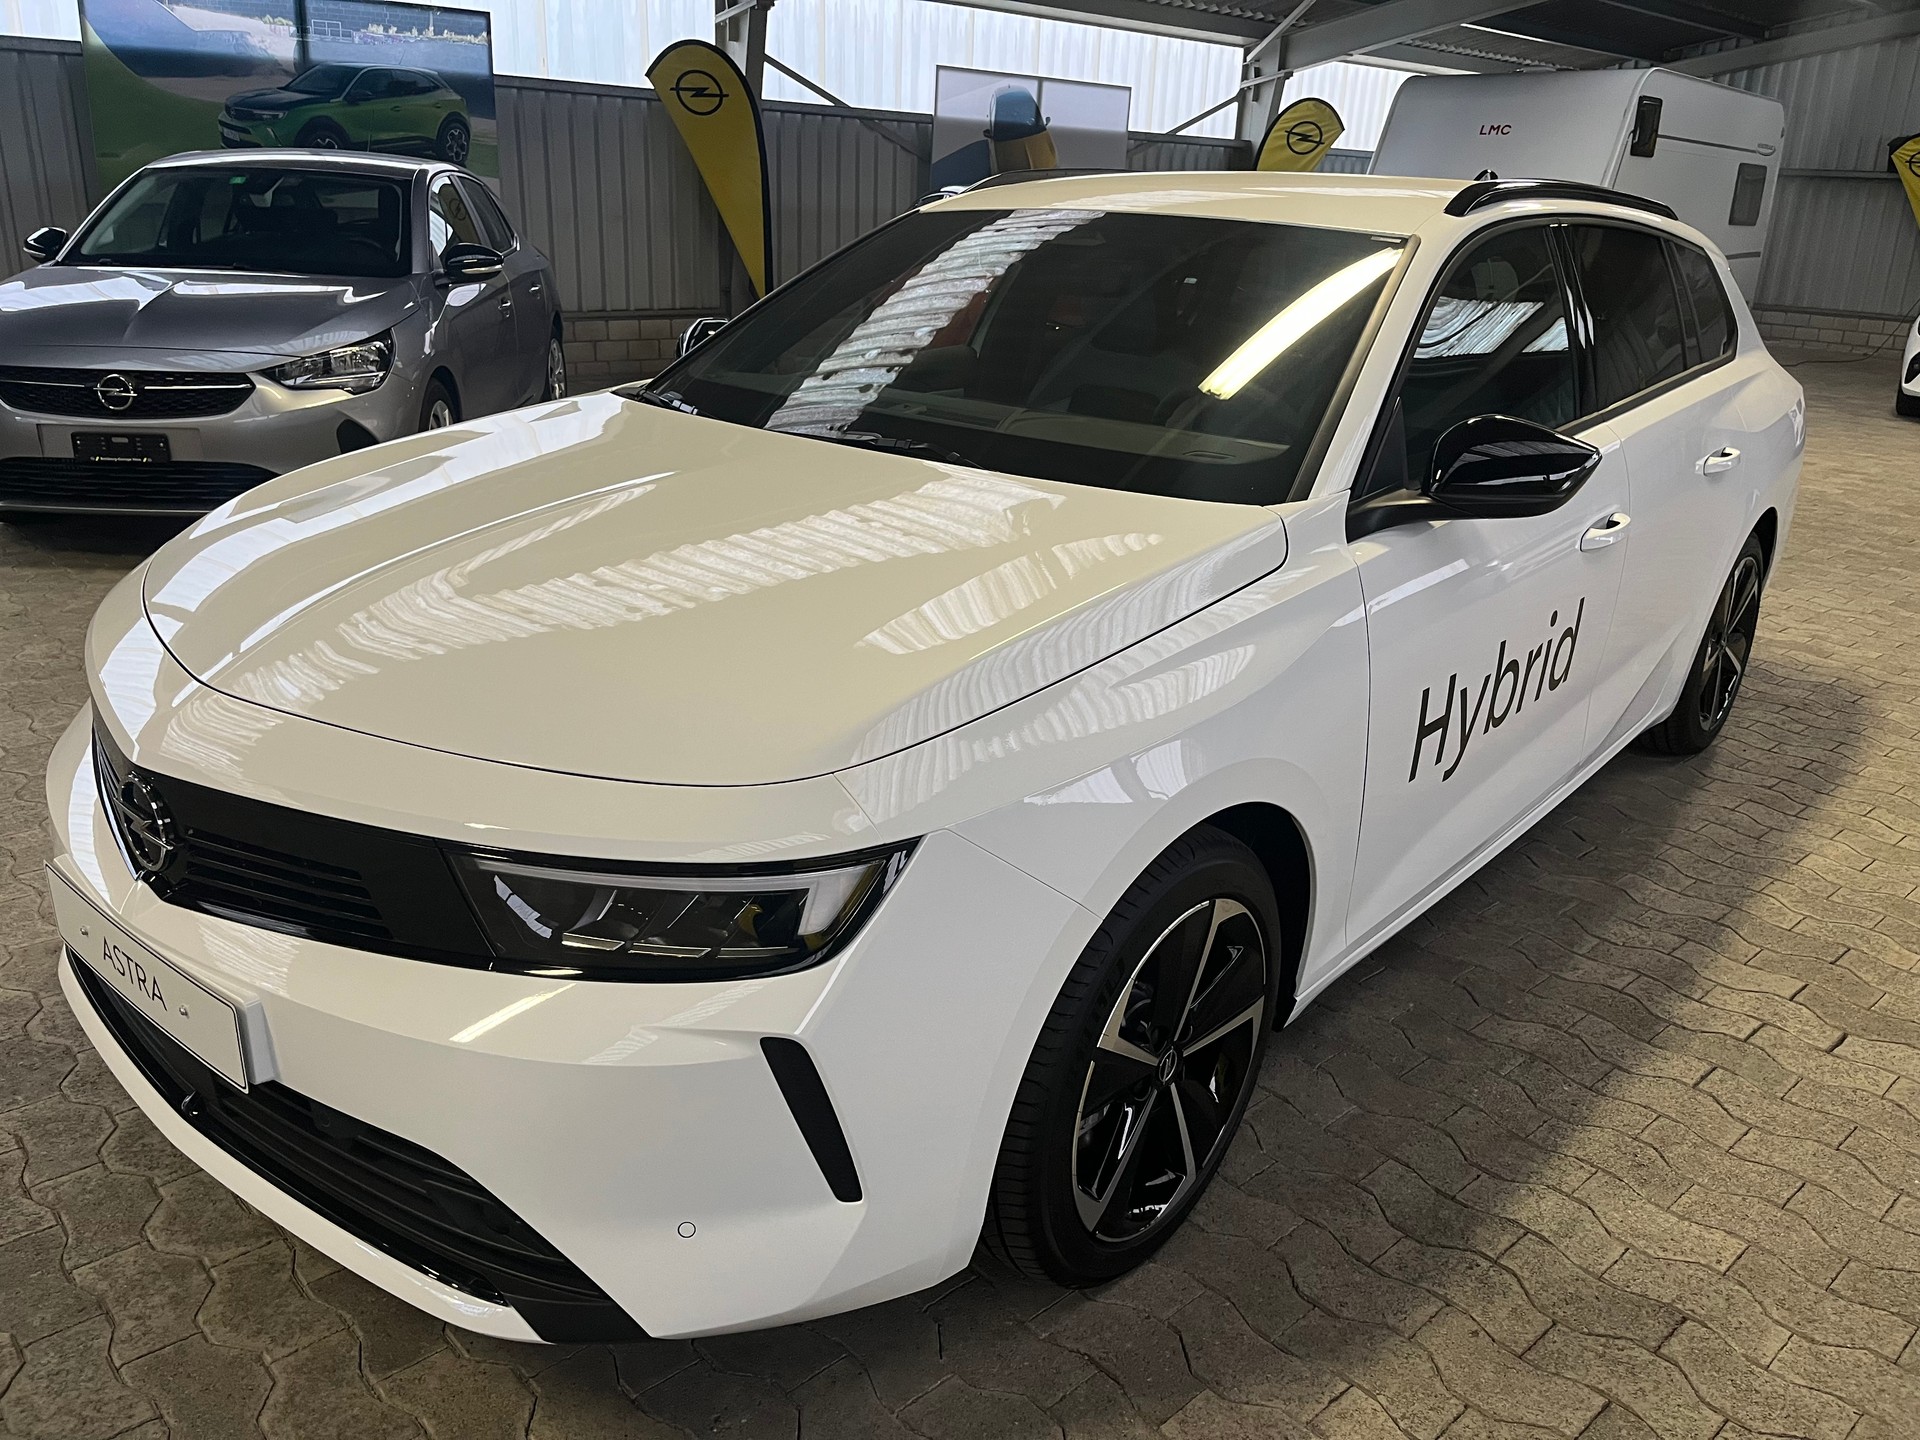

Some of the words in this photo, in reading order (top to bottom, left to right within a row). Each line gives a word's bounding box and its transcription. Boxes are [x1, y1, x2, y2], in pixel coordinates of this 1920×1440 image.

[1479, 124, 1512, 136] LMC
[1408, 596, 1586, 784] Hybrid
[102, 935, 168, 1012] ASTRA
